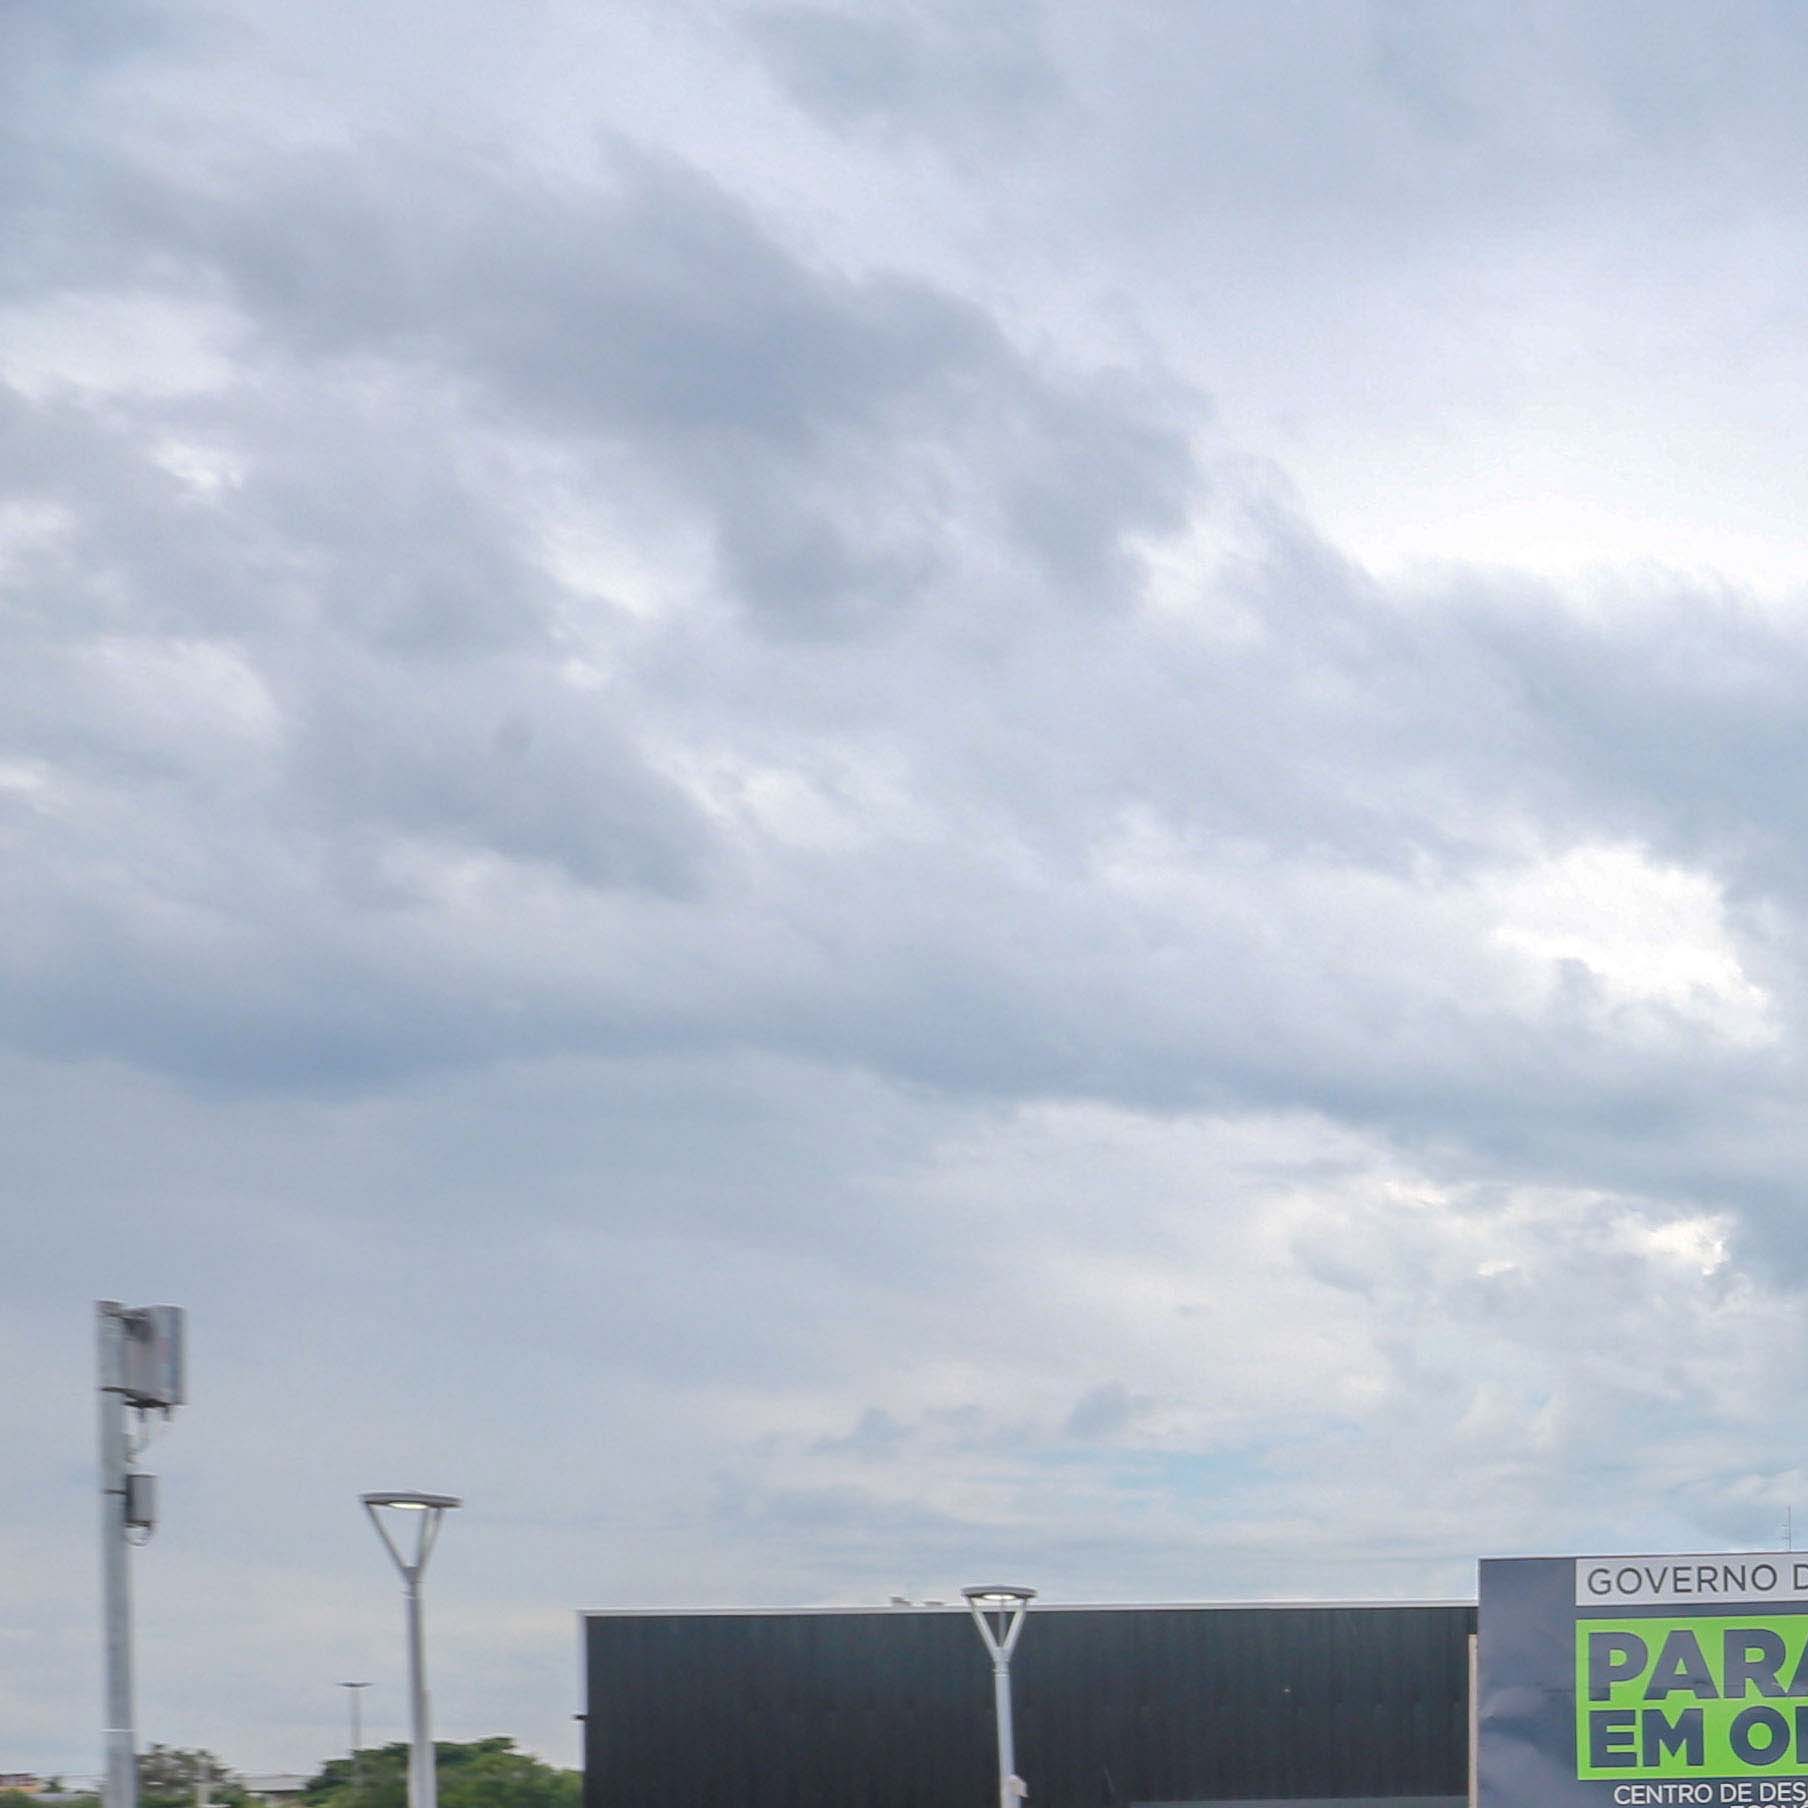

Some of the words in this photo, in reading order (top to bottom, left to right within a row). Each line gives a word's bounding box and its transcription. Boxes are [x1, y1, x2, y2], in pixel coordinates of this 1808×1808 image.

[1587, 1563, 1778, 1595] GOVERNO
[1589, 1708, 1704, 1768] EM
[1614, 1784, 1713, 1805] CENTRO
[1720, 1783, 1751, 1803] DE
